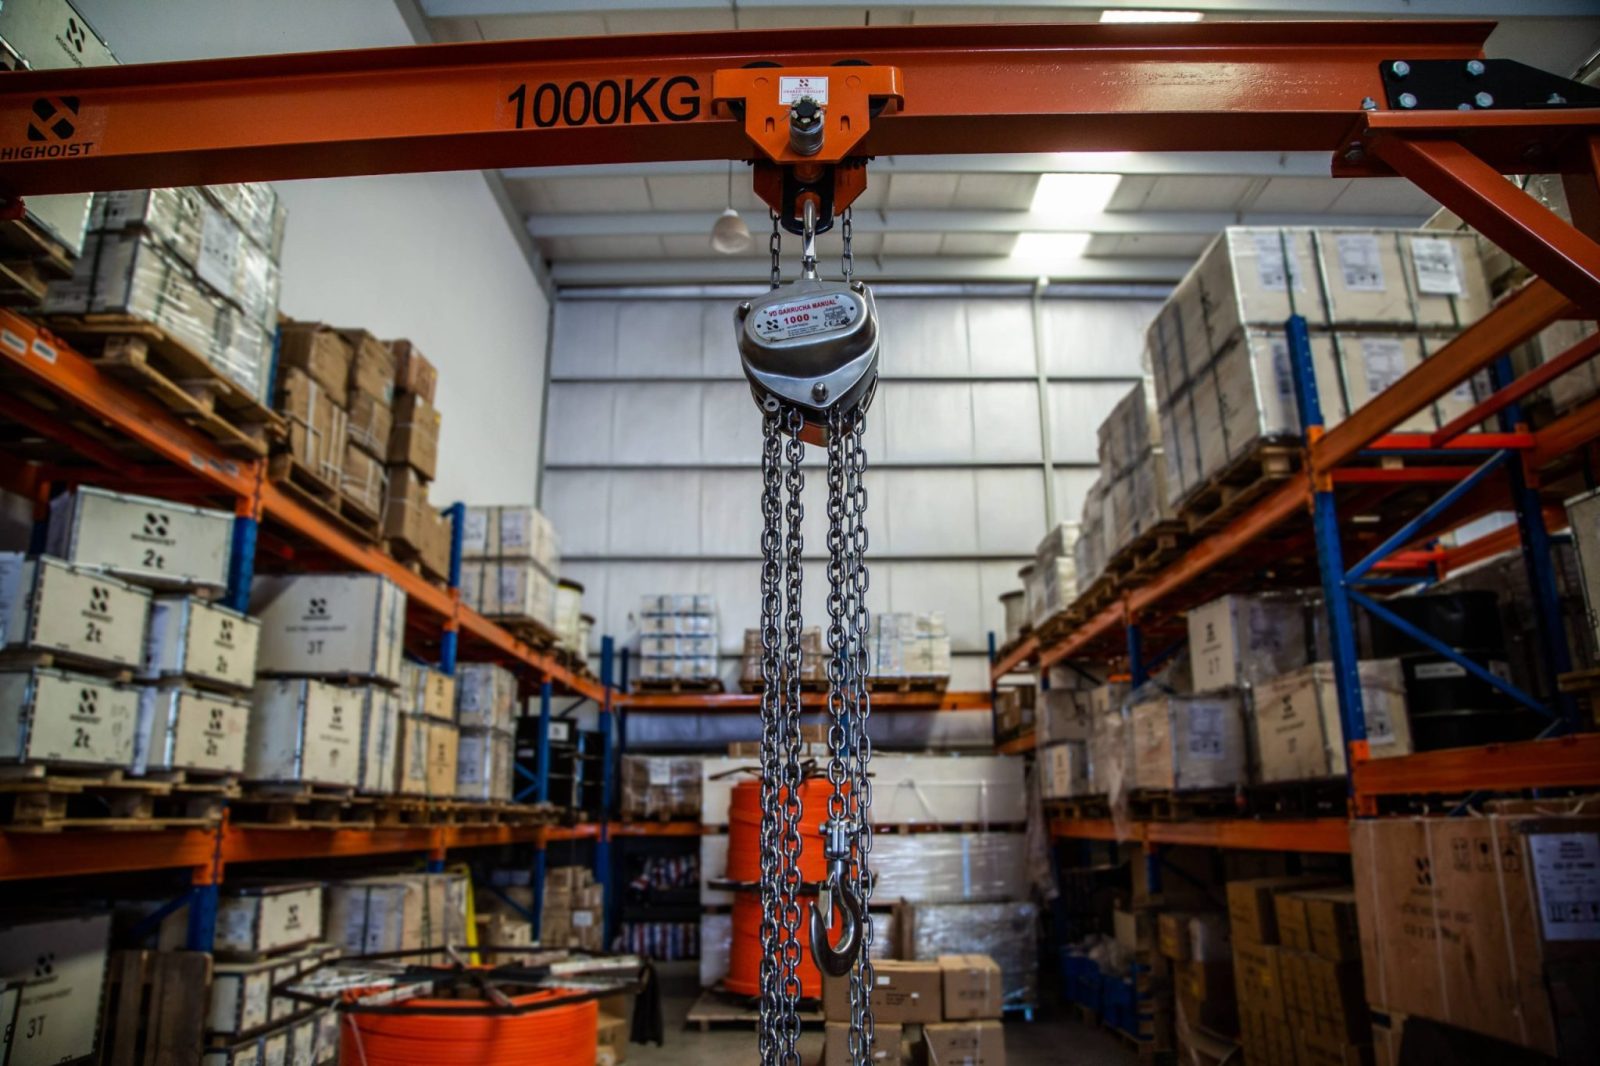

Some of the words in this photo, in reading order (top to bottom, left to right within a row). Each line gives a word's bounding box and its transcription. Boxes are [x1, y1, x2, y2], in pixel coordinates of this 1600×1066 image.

[507, 75, 702, 130] 1000KG
[0, 142, 95, 161] HIGHOIST
[812, 298, 838, 309] MANUAL
[783, 313, 811, 325] 1000
[142, 548, 165, 570] 2t
[85, 622, 103, 644] 2t
[73, 727, 91, 749] 2t
[26, 1014, 47, 1040] 3T
